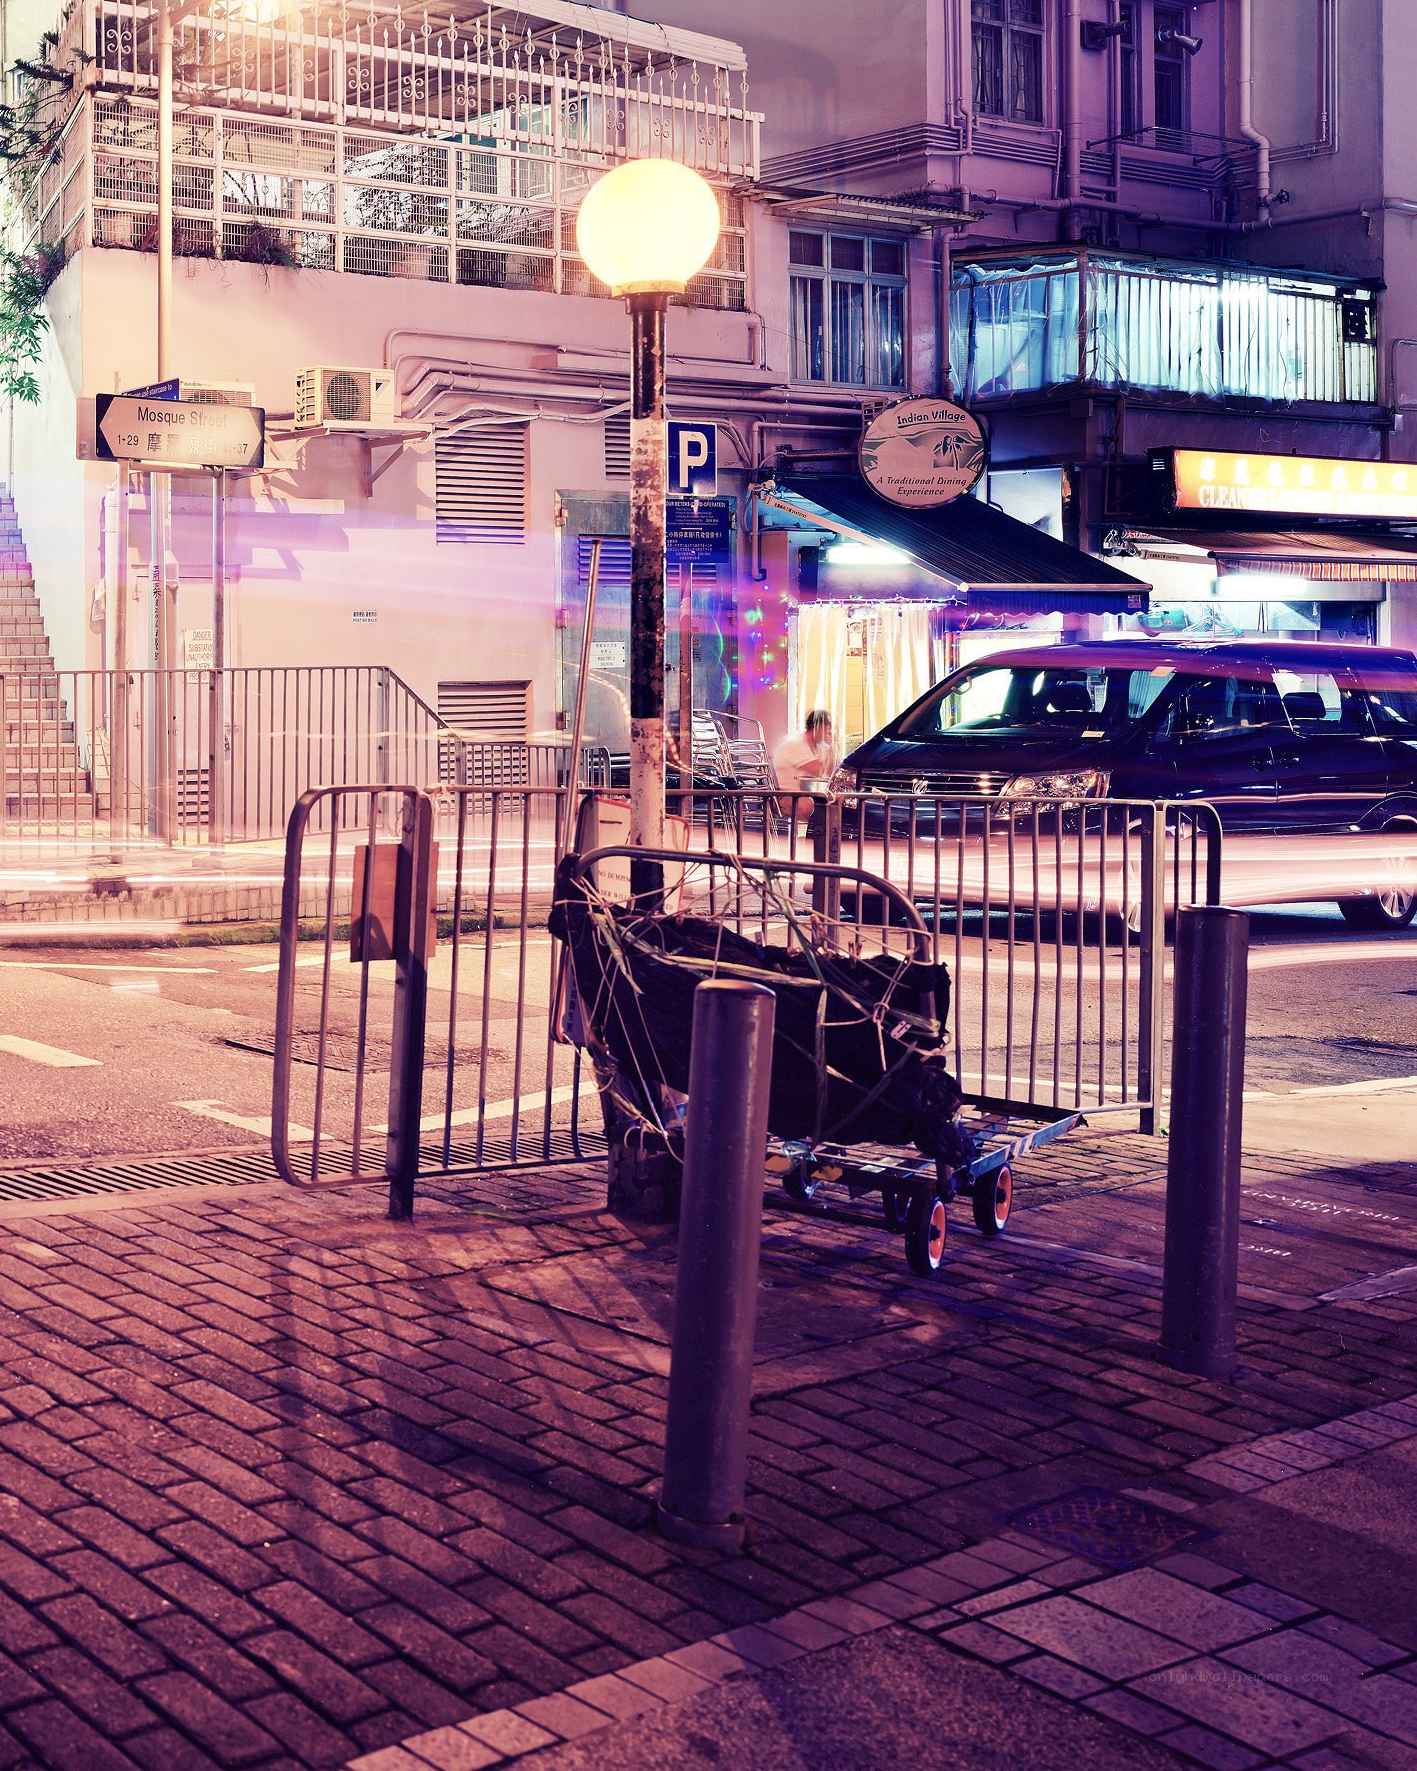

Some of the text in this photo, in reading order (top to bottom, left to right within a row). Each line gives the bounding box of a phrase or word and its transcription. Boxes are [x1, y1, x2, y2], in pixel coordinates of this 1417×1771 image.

[150, 385, 167, 396] staircase
[137, 406, 228, 427] Mosque Street
[897, 410, 966, 424] Indian Village
[117, 434, 139, 446] 1-29
[679, 431, 708, 488] P
[876, 476, 967, 487] A Traditional Dining
[897, 487, 944, 497] Experience
[193, 630, 211, 638] DANGER
[188, 644, 212, 652] SUBSTATIO
[608, 872, 631, 882] DUMPIN
